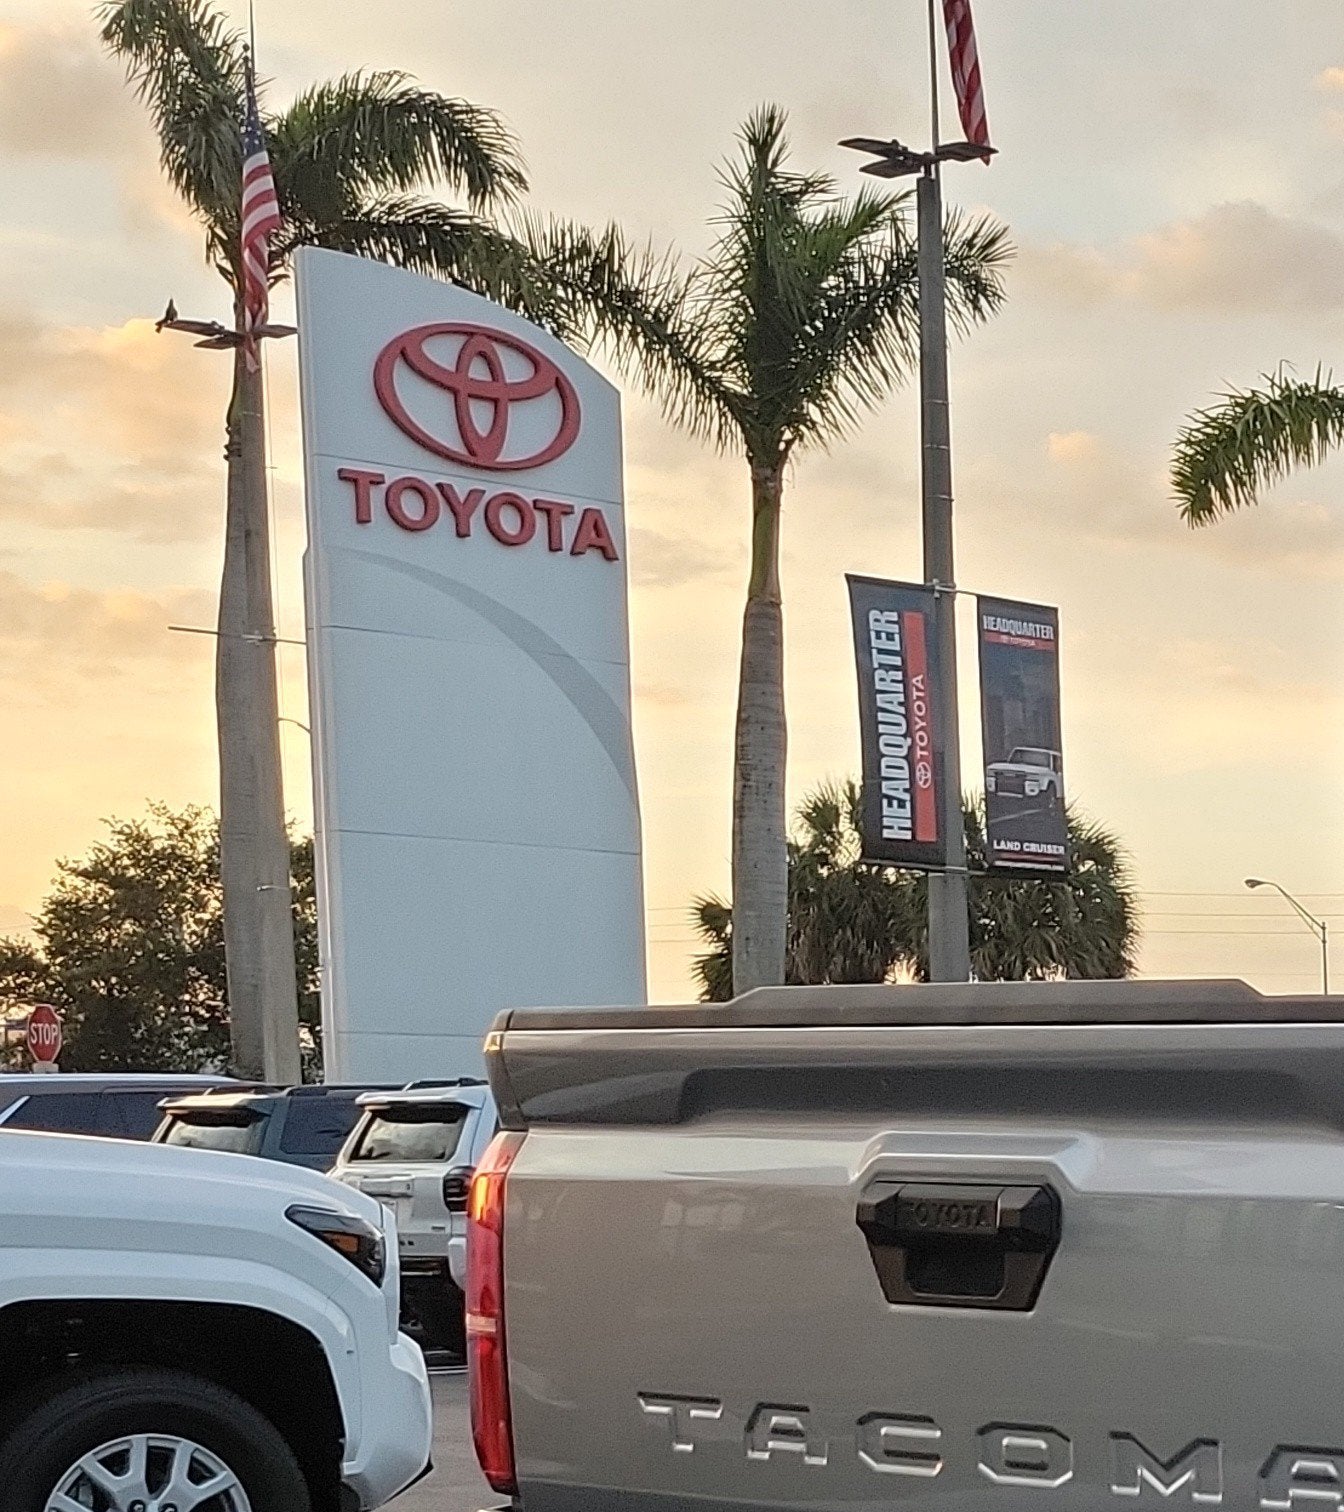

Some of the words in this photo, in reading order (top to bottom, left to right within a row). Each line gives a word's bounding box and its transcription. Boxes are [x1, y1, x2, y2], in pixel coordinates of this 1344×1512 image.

[338, 468, 619, 561] TOYOTA
[982, 614, 1055, 640] HEADQUARTER
[868, 609, 912, 841] HEADQUARTER
[912, 674, 929, 760] TOYOTA
[993, 840, 1021, 851] LAND
[1023, 842, 1065, 855] CRUISER
[30, 1022, 58, 1045] STOP
